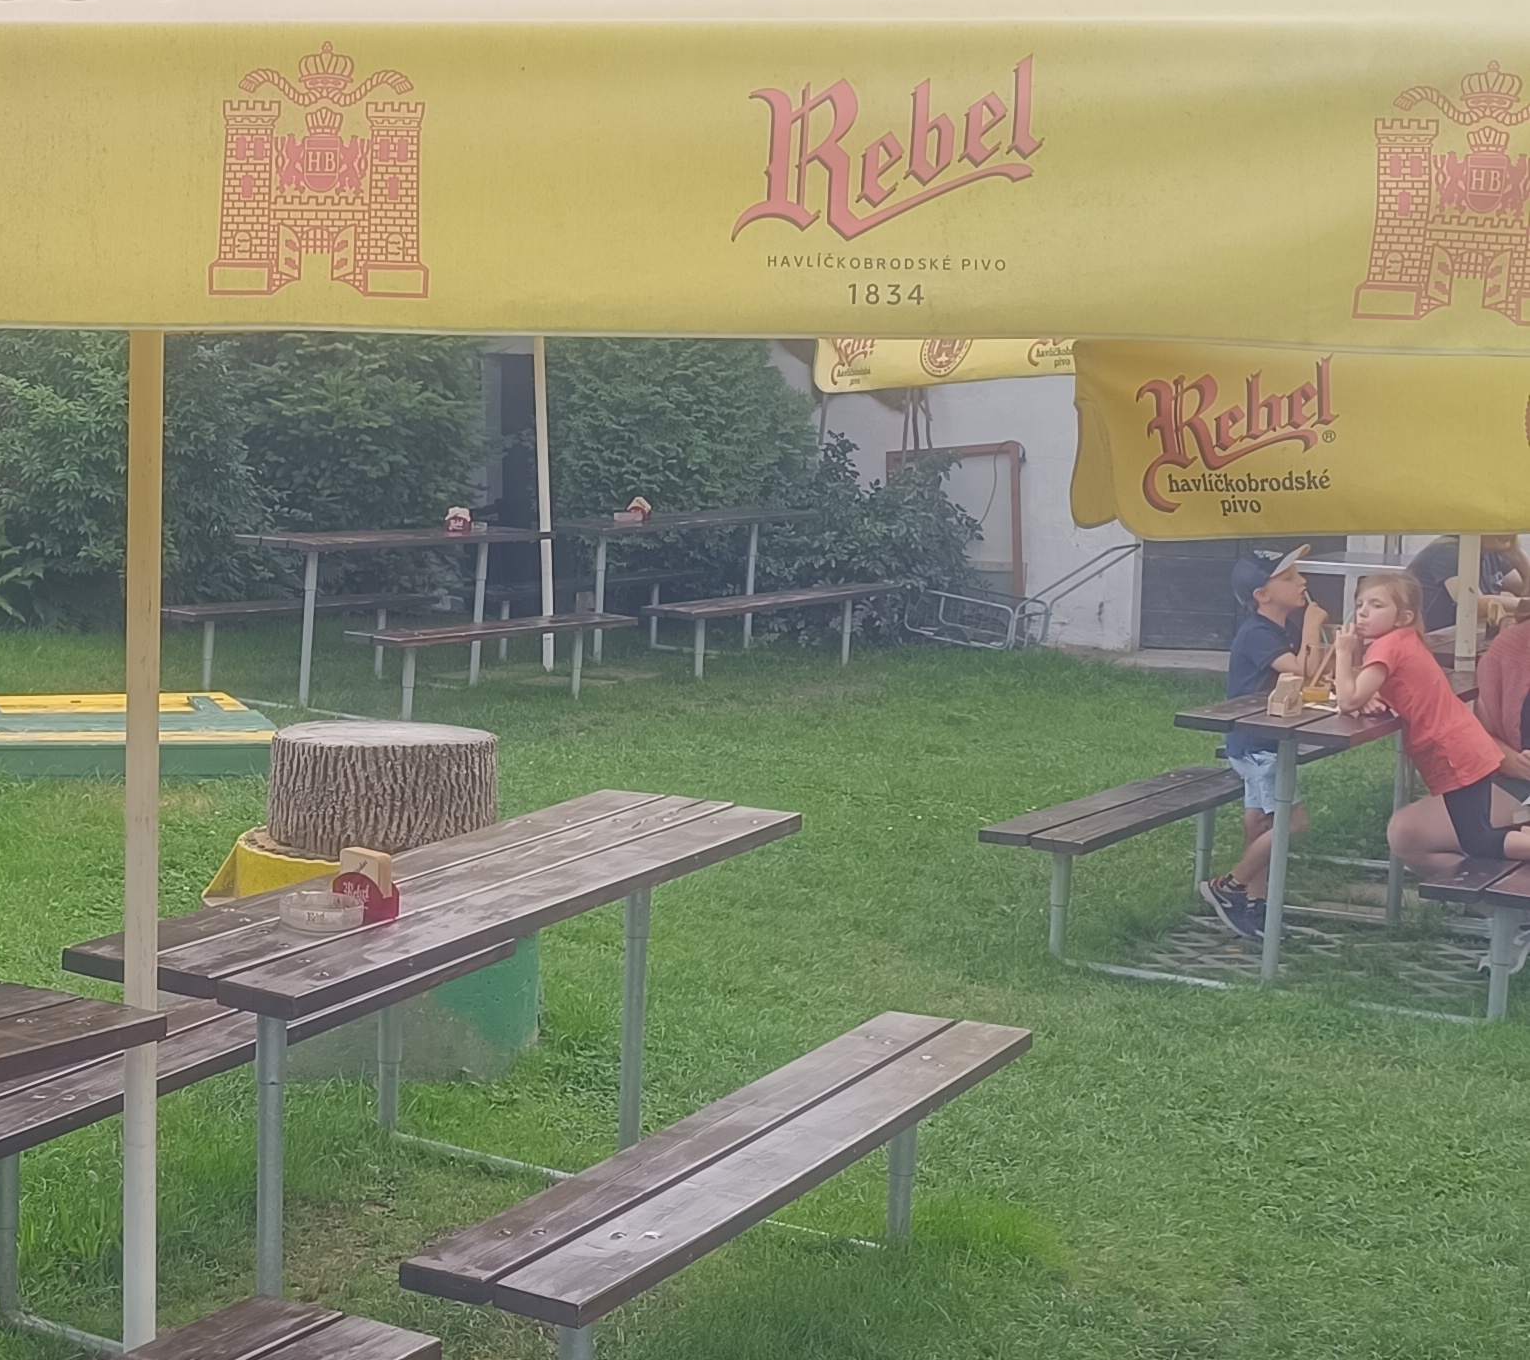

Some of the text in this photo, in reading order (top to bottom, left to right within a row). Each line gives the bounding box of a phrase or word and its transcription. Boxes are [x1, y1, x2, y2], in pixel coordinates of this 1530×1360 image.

[730, 53, 1045, 242] Rebel
[307, 151, 336, 172] HB
[767, 252, 1007, 272] HAVLÍČKOBRODSKÉ PIVO
[847, 283, 926, 306] 1834
[1135, 352, 1340, 514] Rebel
[1167, 468, 1332, 493] havlíčkobrodské
[1220, 494, 1262, 516] pivo
